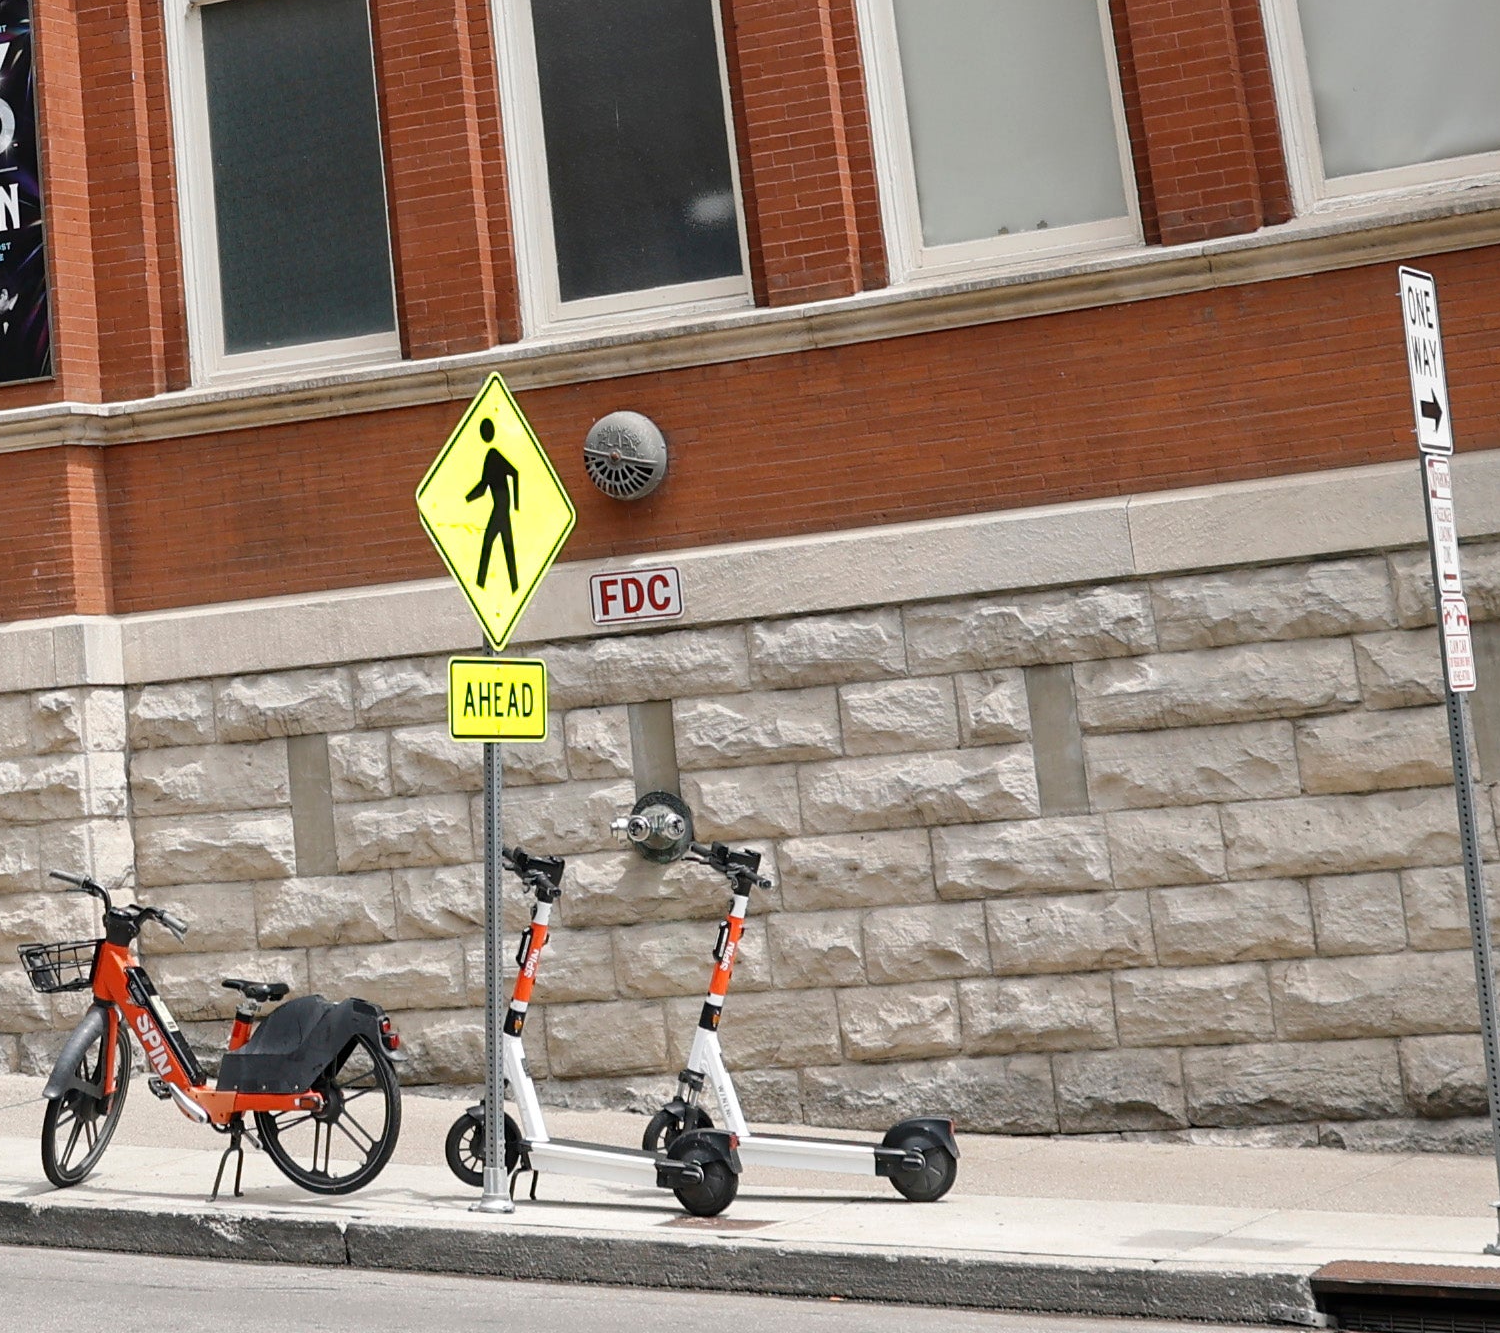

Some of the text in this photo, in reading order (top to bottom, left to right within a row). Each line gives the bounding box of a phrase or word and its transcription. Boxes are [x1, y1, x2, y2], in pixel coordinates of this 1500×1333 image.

[1407, 285, 1434, 330] ONE
[1411, 336, 1438, 378] WAY
[599, 574, 671, 615] FDC
[464, 682, 534, 717] AHEAD
[524, 948, 539, 978] SPIN
[719, 941, 735, 971] SPIN
[137, 1014, 172, 1075] SPIN
